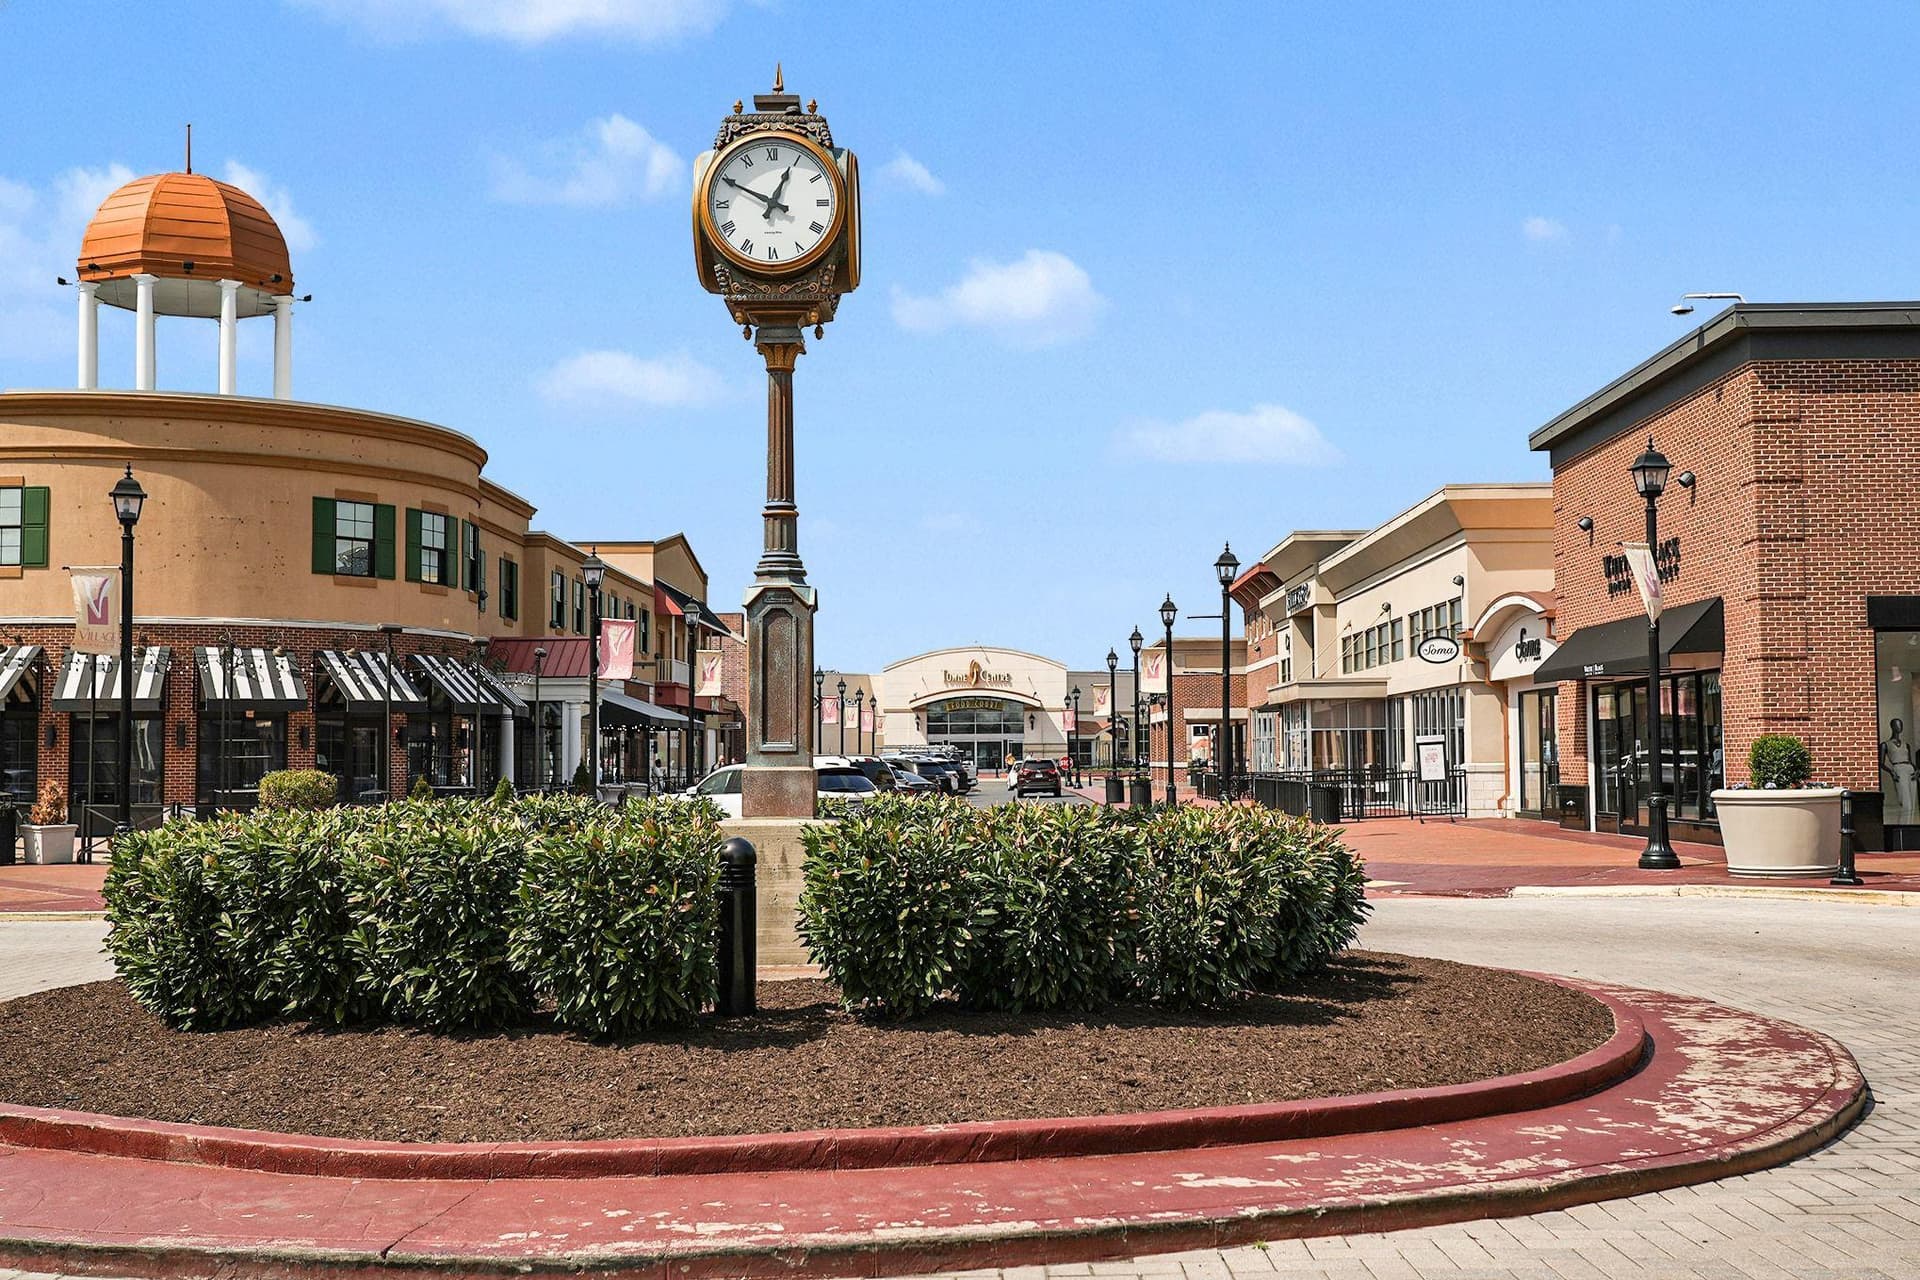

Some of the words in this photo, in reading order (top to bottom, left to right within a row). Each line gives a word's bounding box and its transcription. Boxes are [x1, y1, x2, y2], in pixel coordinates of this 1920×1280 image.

[766, 148, 778, 161] XII
[740, 155, 754, 169] XI
[1422, 643, 1456, 656] Soma
